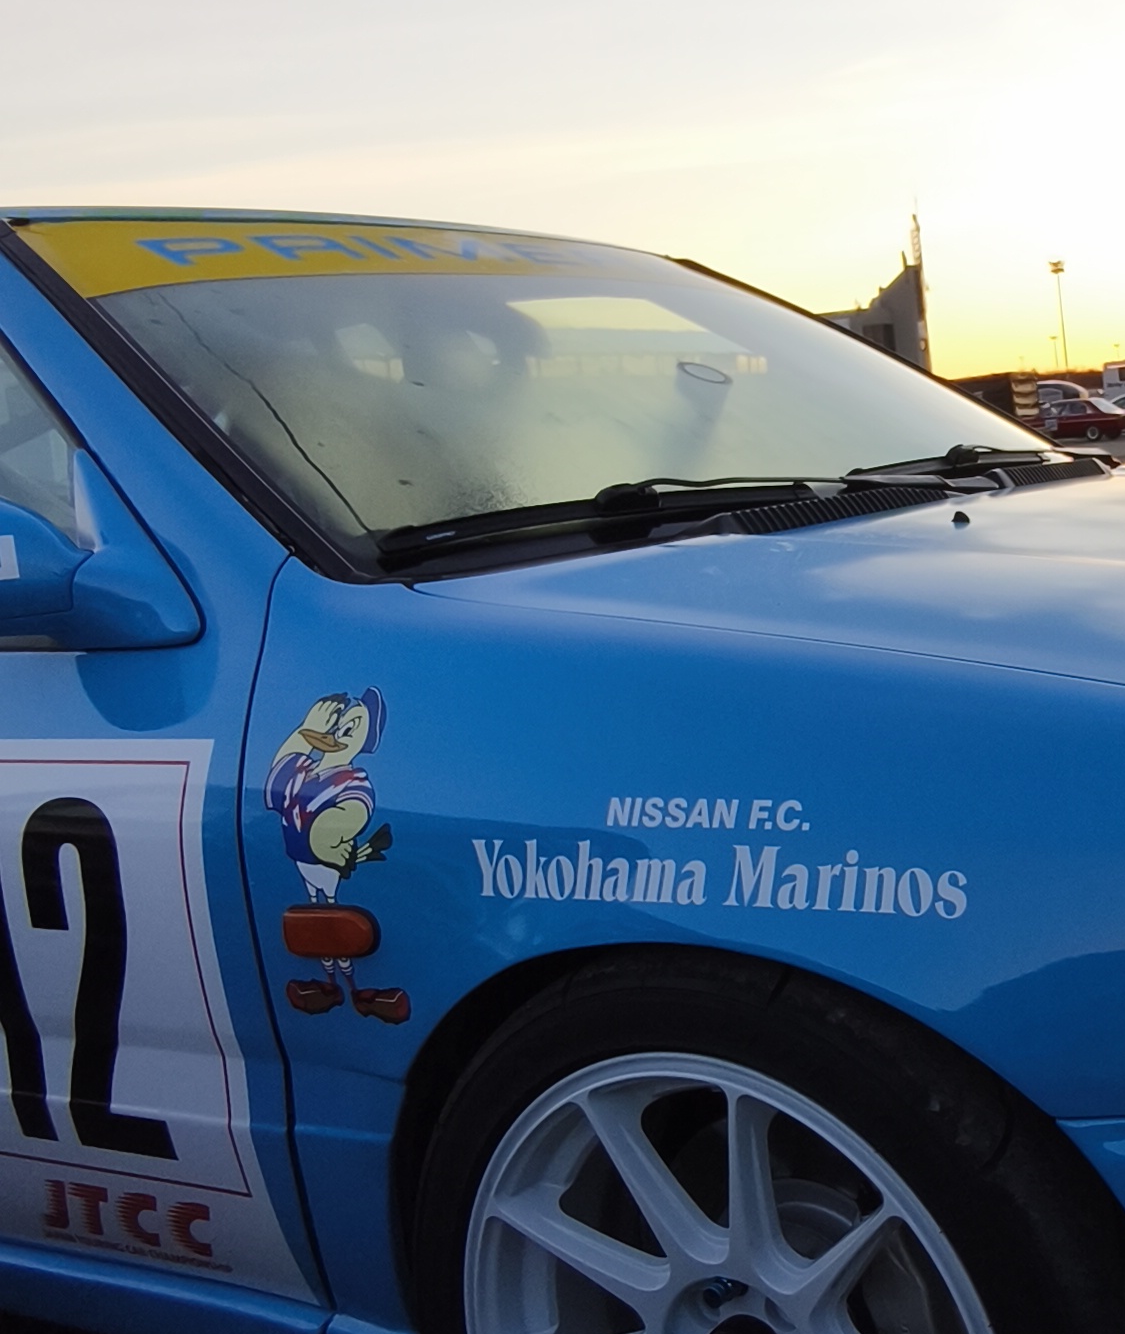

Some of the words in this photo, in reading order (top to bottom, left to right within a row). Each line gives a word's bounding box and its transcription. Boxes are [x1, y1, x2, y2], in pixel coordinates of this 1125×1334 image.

[136, 233, 600, 267] PRIME
[607, 797, 739, 830] NISSAN
[748, 799, 811, 831] F.C.
[472, 837, 708, 905] Yokohama
[723, 844, 968, 919] Marinos
[43, 1178, 213, 1257] JTCC
